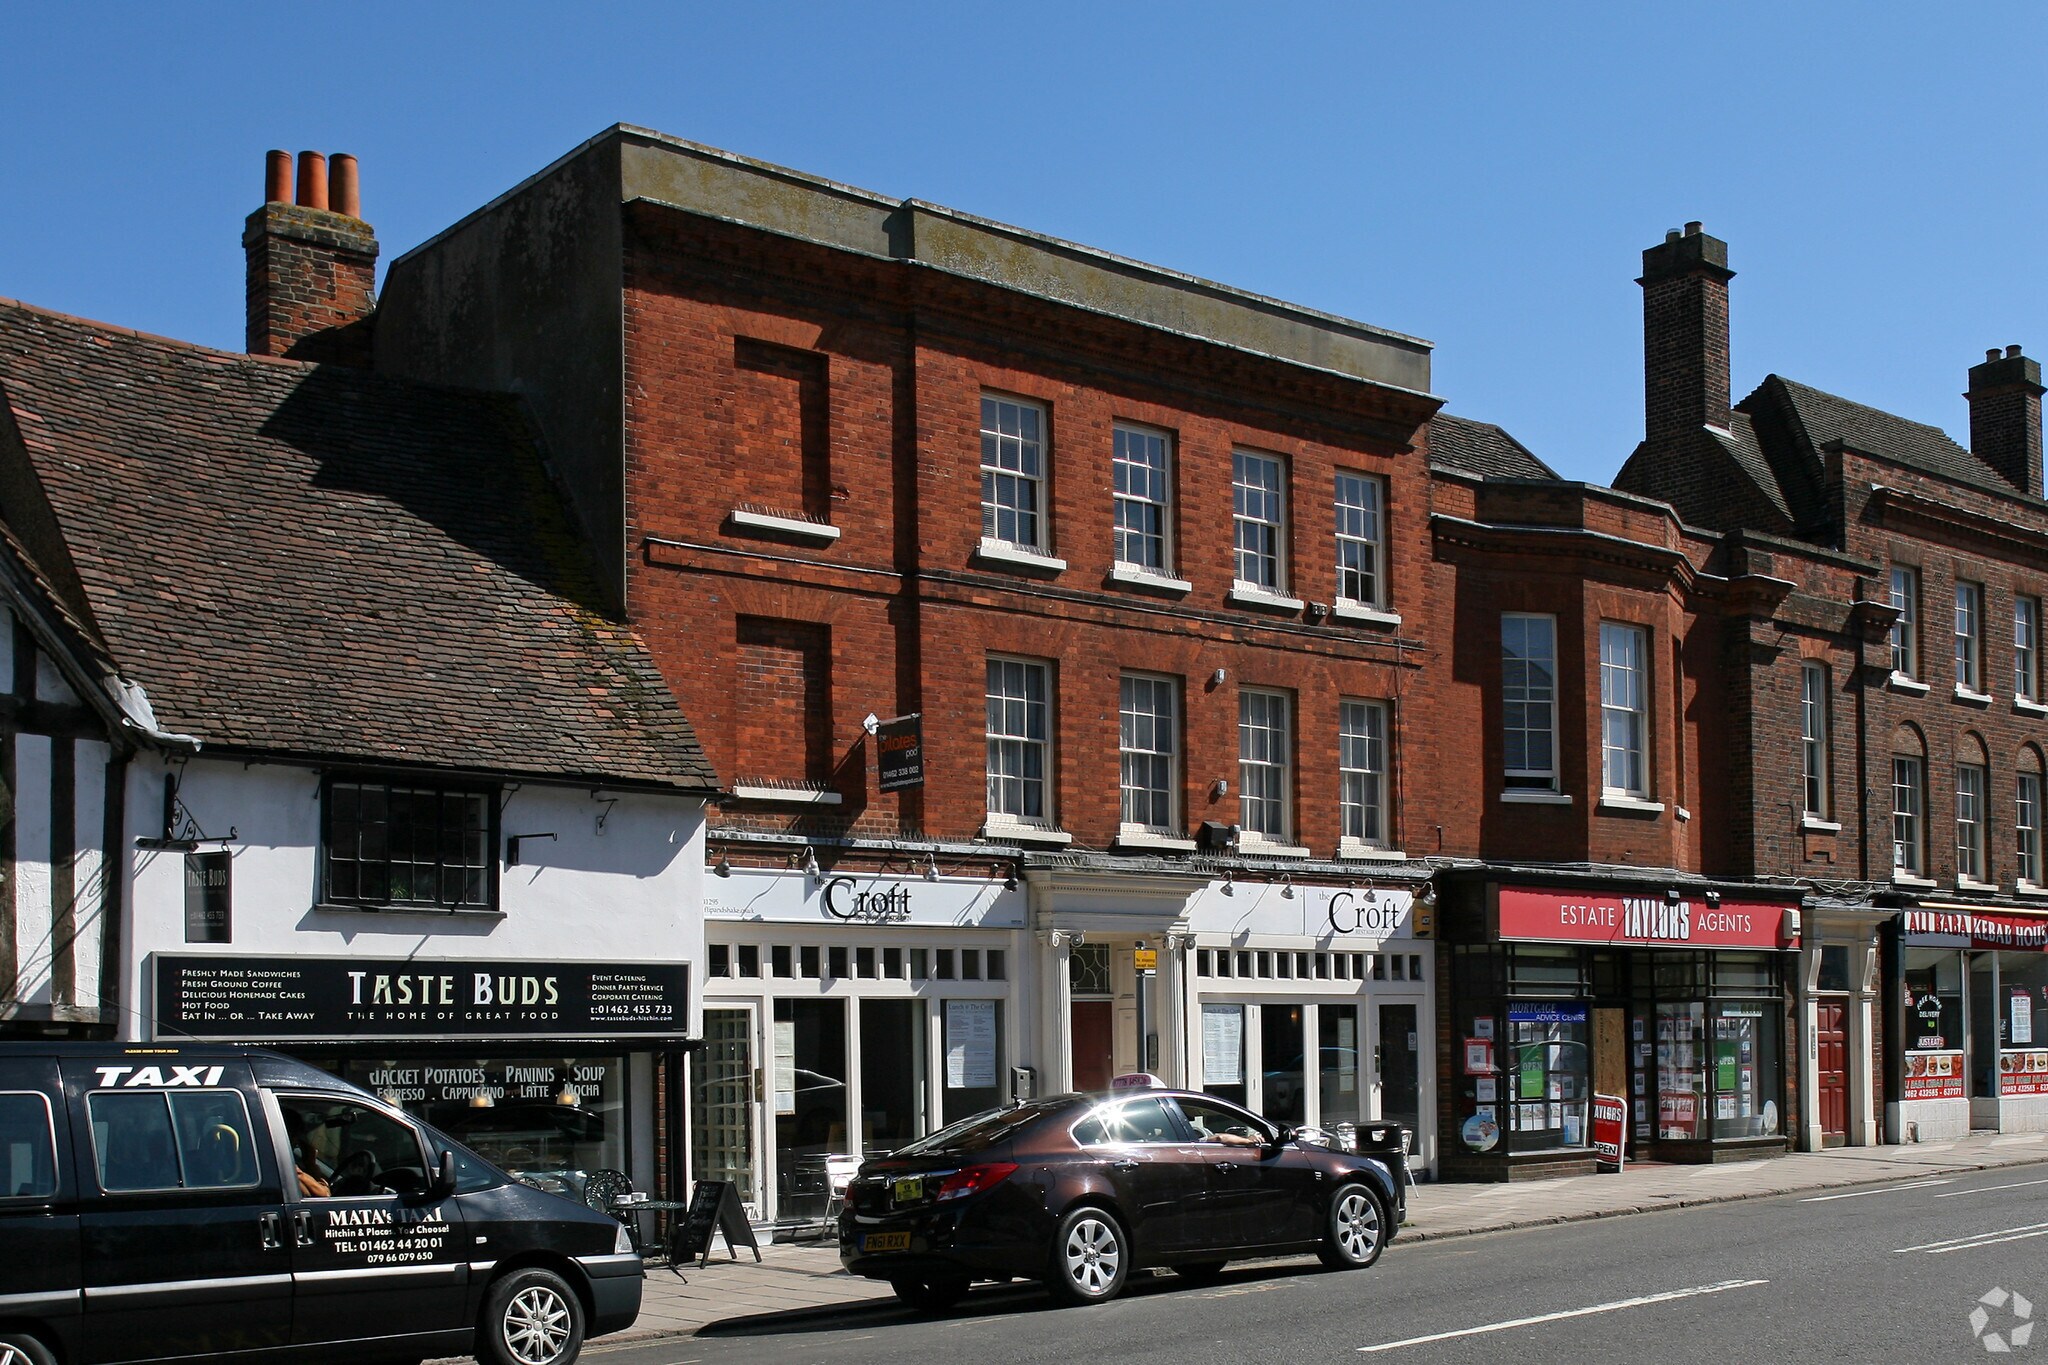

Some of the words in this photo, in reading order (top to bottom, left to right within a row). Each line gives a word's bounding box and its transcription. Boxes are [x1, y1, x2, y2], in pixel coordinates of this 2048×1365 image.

[188, 871, 206, 887] TASTE
[209, 869, 226, 886] BUDS
[826, 877, 912, 918] Croft
[1319, 891, 1330, 901] the
[1329, 892, 1398, 933] Croft
[1560, 905, 1615, 926] ESTATE
[1623, 898, 1690, 939] TAYLORS
[1697, 913, 1751, 932] AGENTS
[1909, 912, 1929, 935] ALI
[1934, 913, 1968, 937] BABA
[1973, 918, 2011, 944] KEBAB
[247, 970, 300, 978] SANDWICHES
[348, 972, 454, 1005] TASTE
[474, 973, 559, 1005] BUDS
[1510, 1003, 1557, 1013] MORTGAGE
[1917, 995, 1928, 1010] FREE
[182, 1012, 201, 1020] EAT
[205, 1012, 215, 1020] IN
[259, 1012, 282, 1020] TAKE
[286, 1012, 315, 1020] AWAY
[1523, 1061, 1542, 1071] OPEN
[95, 1066, 225, 1087] TAXI
[370, 1067, 419, 1086] JACKET
[425, 1066, 485, 1084] POTATOES
[506, 1065, 555, 1083] PANINIS
[574, 1065, 605, 1081] SOUP
[376, 1087, 425, 1101] ESPRESSO
[442, 1086, 504, 1100] CAPPUCCINO
[521, 1084, 549, 1098] LATTE
[565, 1084, 599, 1097] MOCHA
[1594, 1105, 1622, 1121] AYLORS
[329, 1209, 392, 1226] MATA's
[397, 1207, 443, 1223] TAXI
[325, 1228, 356, 1238] Hitchin
[398, 1226, 414, 1235] You
[416, 1224, 449, 1233] Choose!
[335, 1242, 357, 1252] TEL:
[360, 1240, 395, 1251] 01462
[397, 1239, 412, 1250] 44
[415, 1238, 429, 1249] 20
[431, 1237, 443, 1248] 01
[866, 1235, 885, 1249] FN61
[887, 1233, 905, 1248] RXX
[367, 1254, 384, 1263] 079
[386, 1253, 397, 1262] 66
[399, 1253, 415, 1261] 079
[417, 1252, 433, 1260] 650
